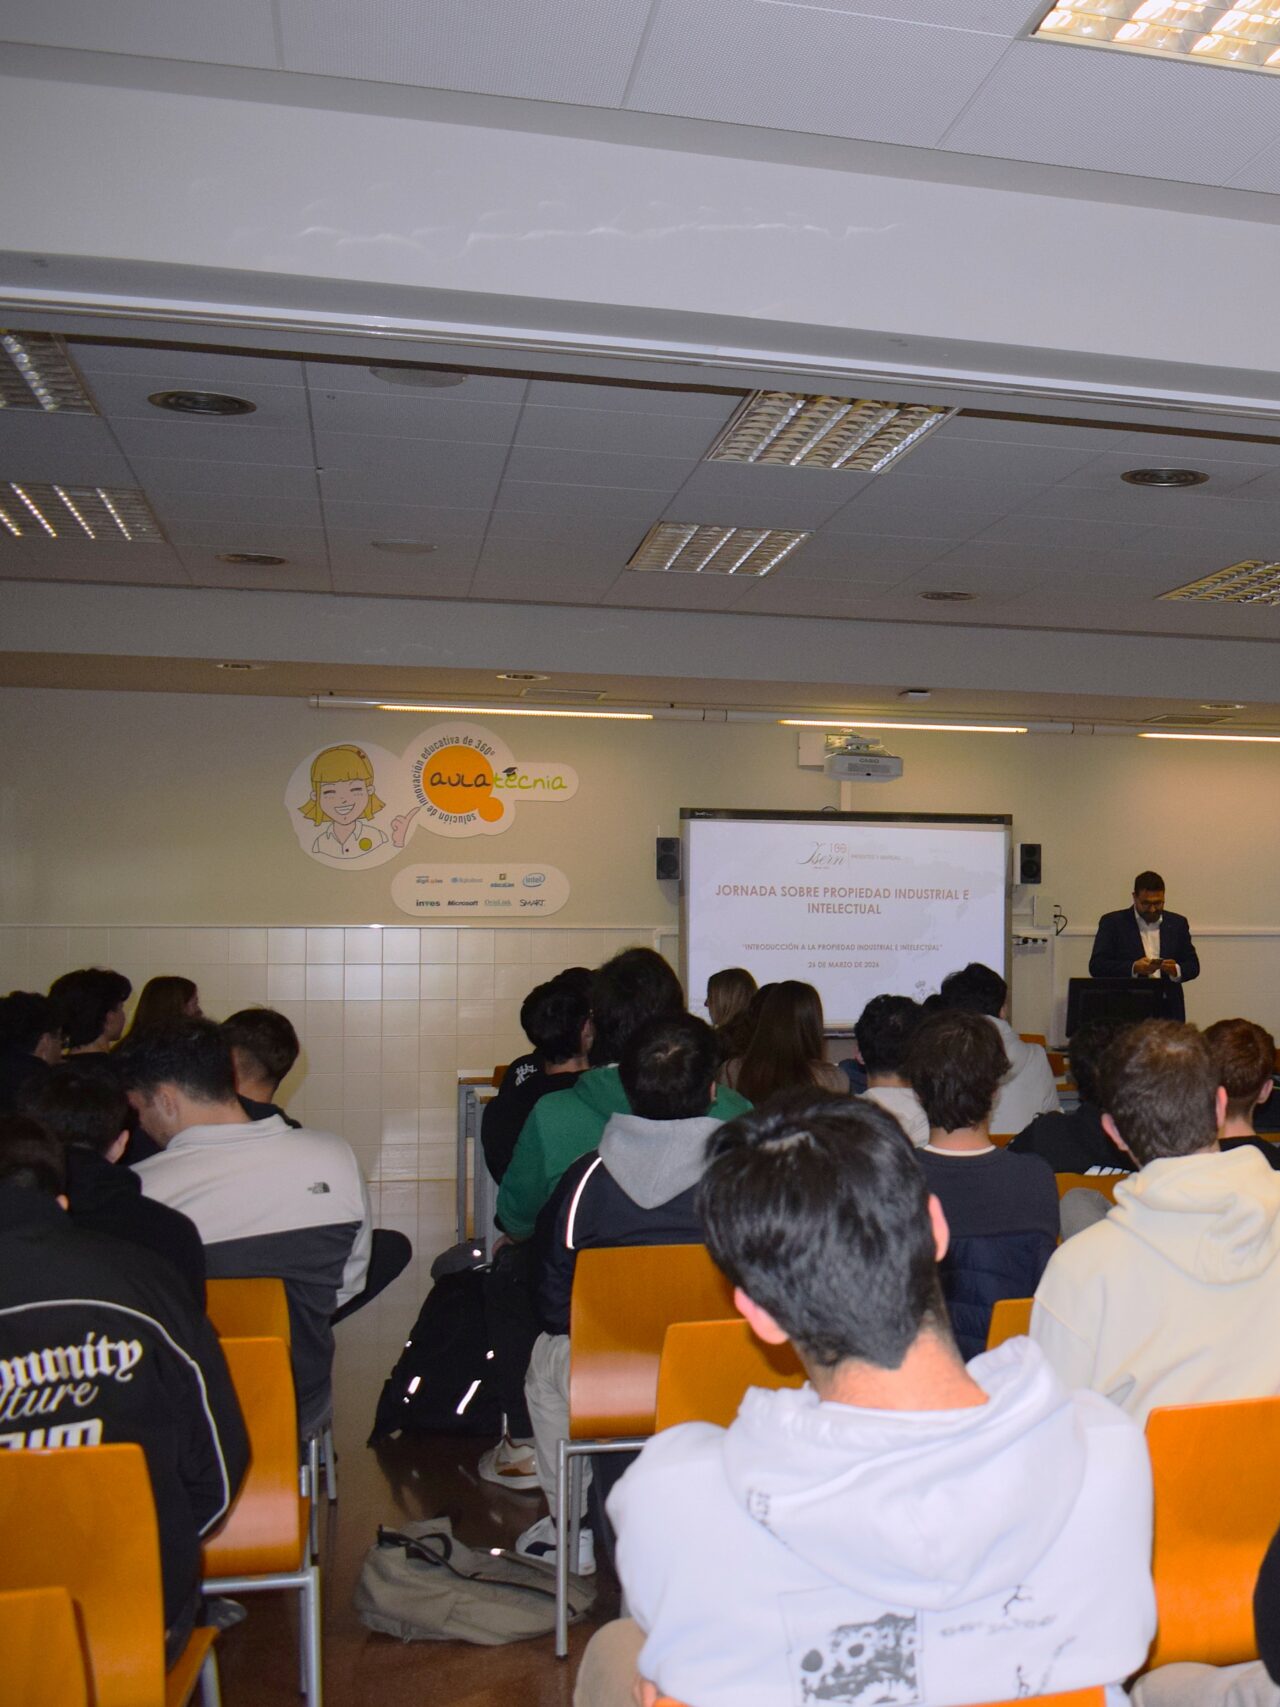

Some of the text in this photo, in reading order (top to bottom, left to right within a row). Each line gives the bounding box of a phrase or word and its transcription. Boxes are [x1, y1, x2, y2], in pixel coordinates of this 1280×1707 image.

[421, 735, 460, 759] educativa
[463, 736, 473, 745] de
[715, 884, 970, 900] JORNADA SOBRE PROPIEDAD INDUSTRIAL E
[807, 902, 882, 915] INTELECTUAL
[807, 943, 816, 951] LA
[817, 943, 856, 951] PROPIEDAD
[857, 943, 893, 951] INDUSTRIAL
[828, 961, 853, 969] MARZO
